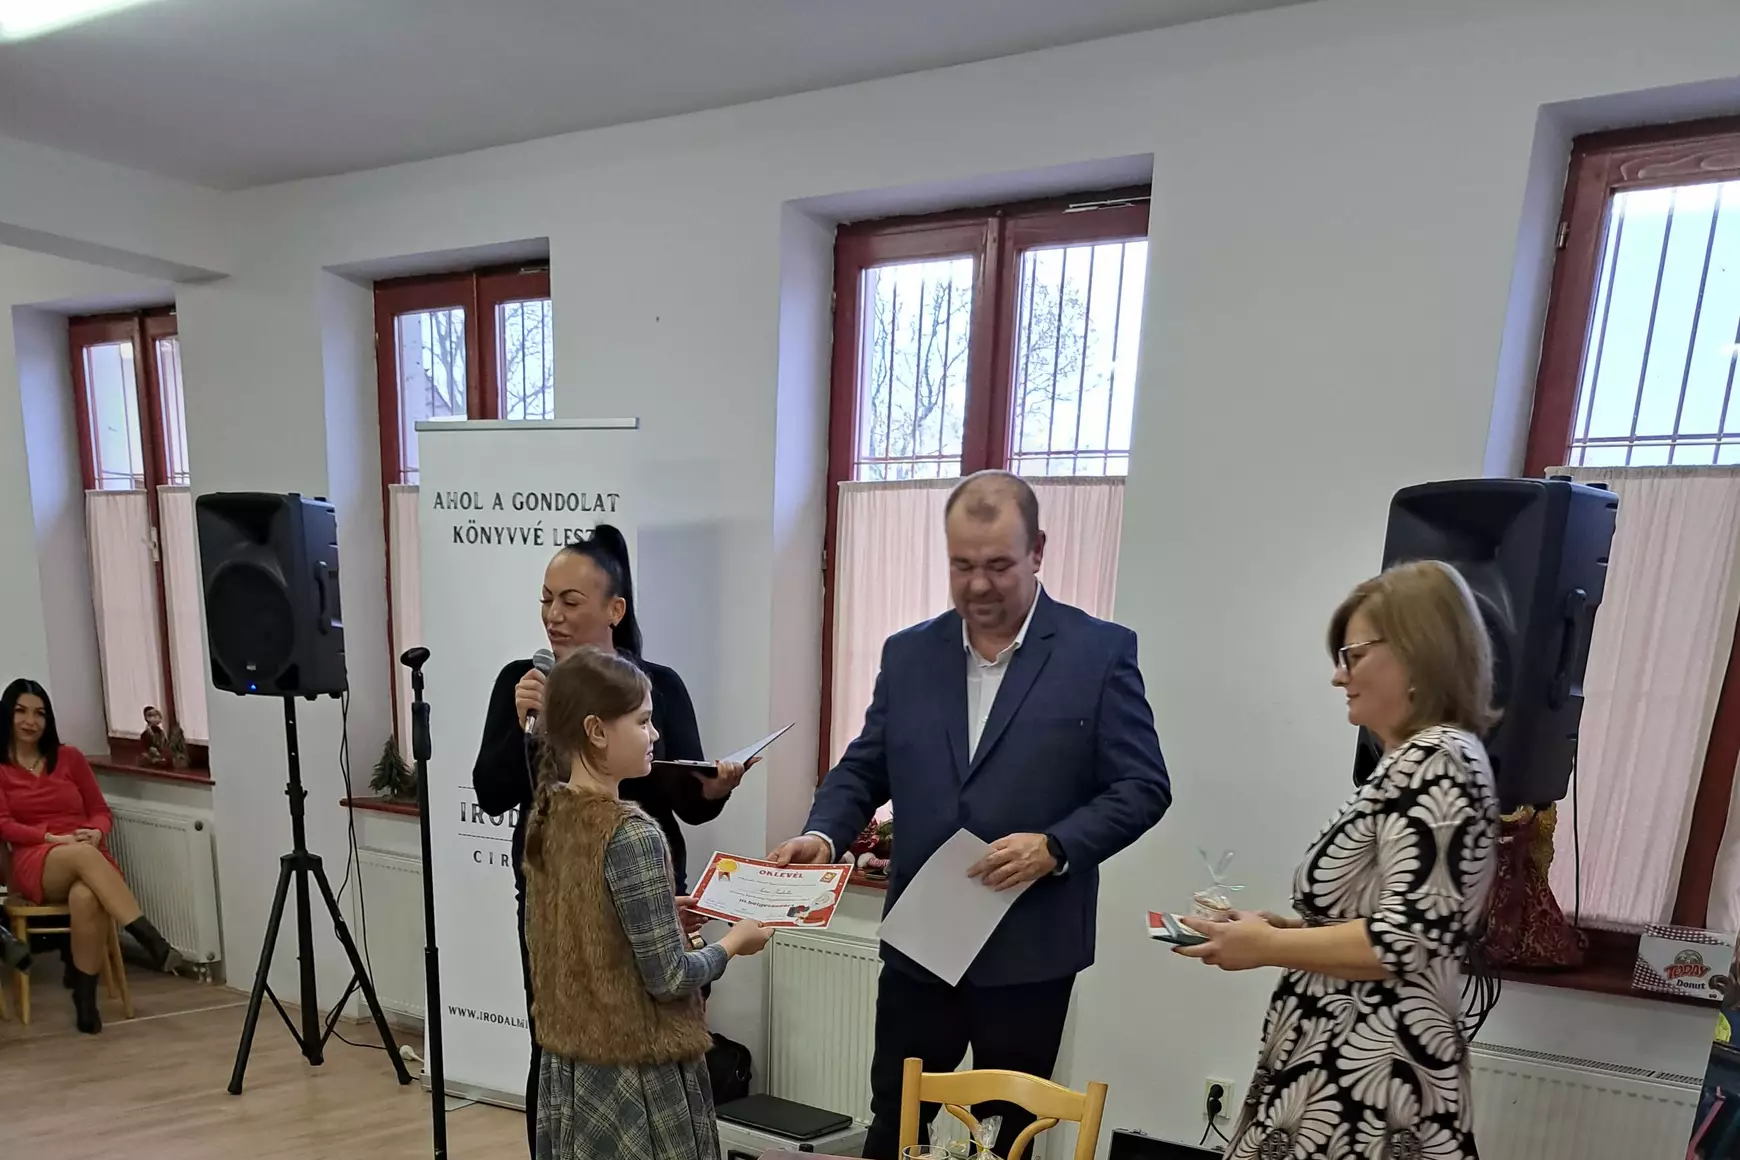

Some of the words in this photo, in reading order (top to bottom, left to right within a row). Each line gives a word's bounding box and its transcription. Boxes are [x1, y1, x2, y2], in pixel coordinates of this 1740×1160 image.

[434, 491, 484, 511] AHOL
[491, 492, 504, 511] A
[511, 492, 621, 513] GONDOLAT
[453, 520, 545, 546] KÖNYVVÉ
[759, 869, 804, 879] OKLEVÉL
[1664, 964, 1711, 980] TODAY
[1676, 979, 1706, 990] Donut
